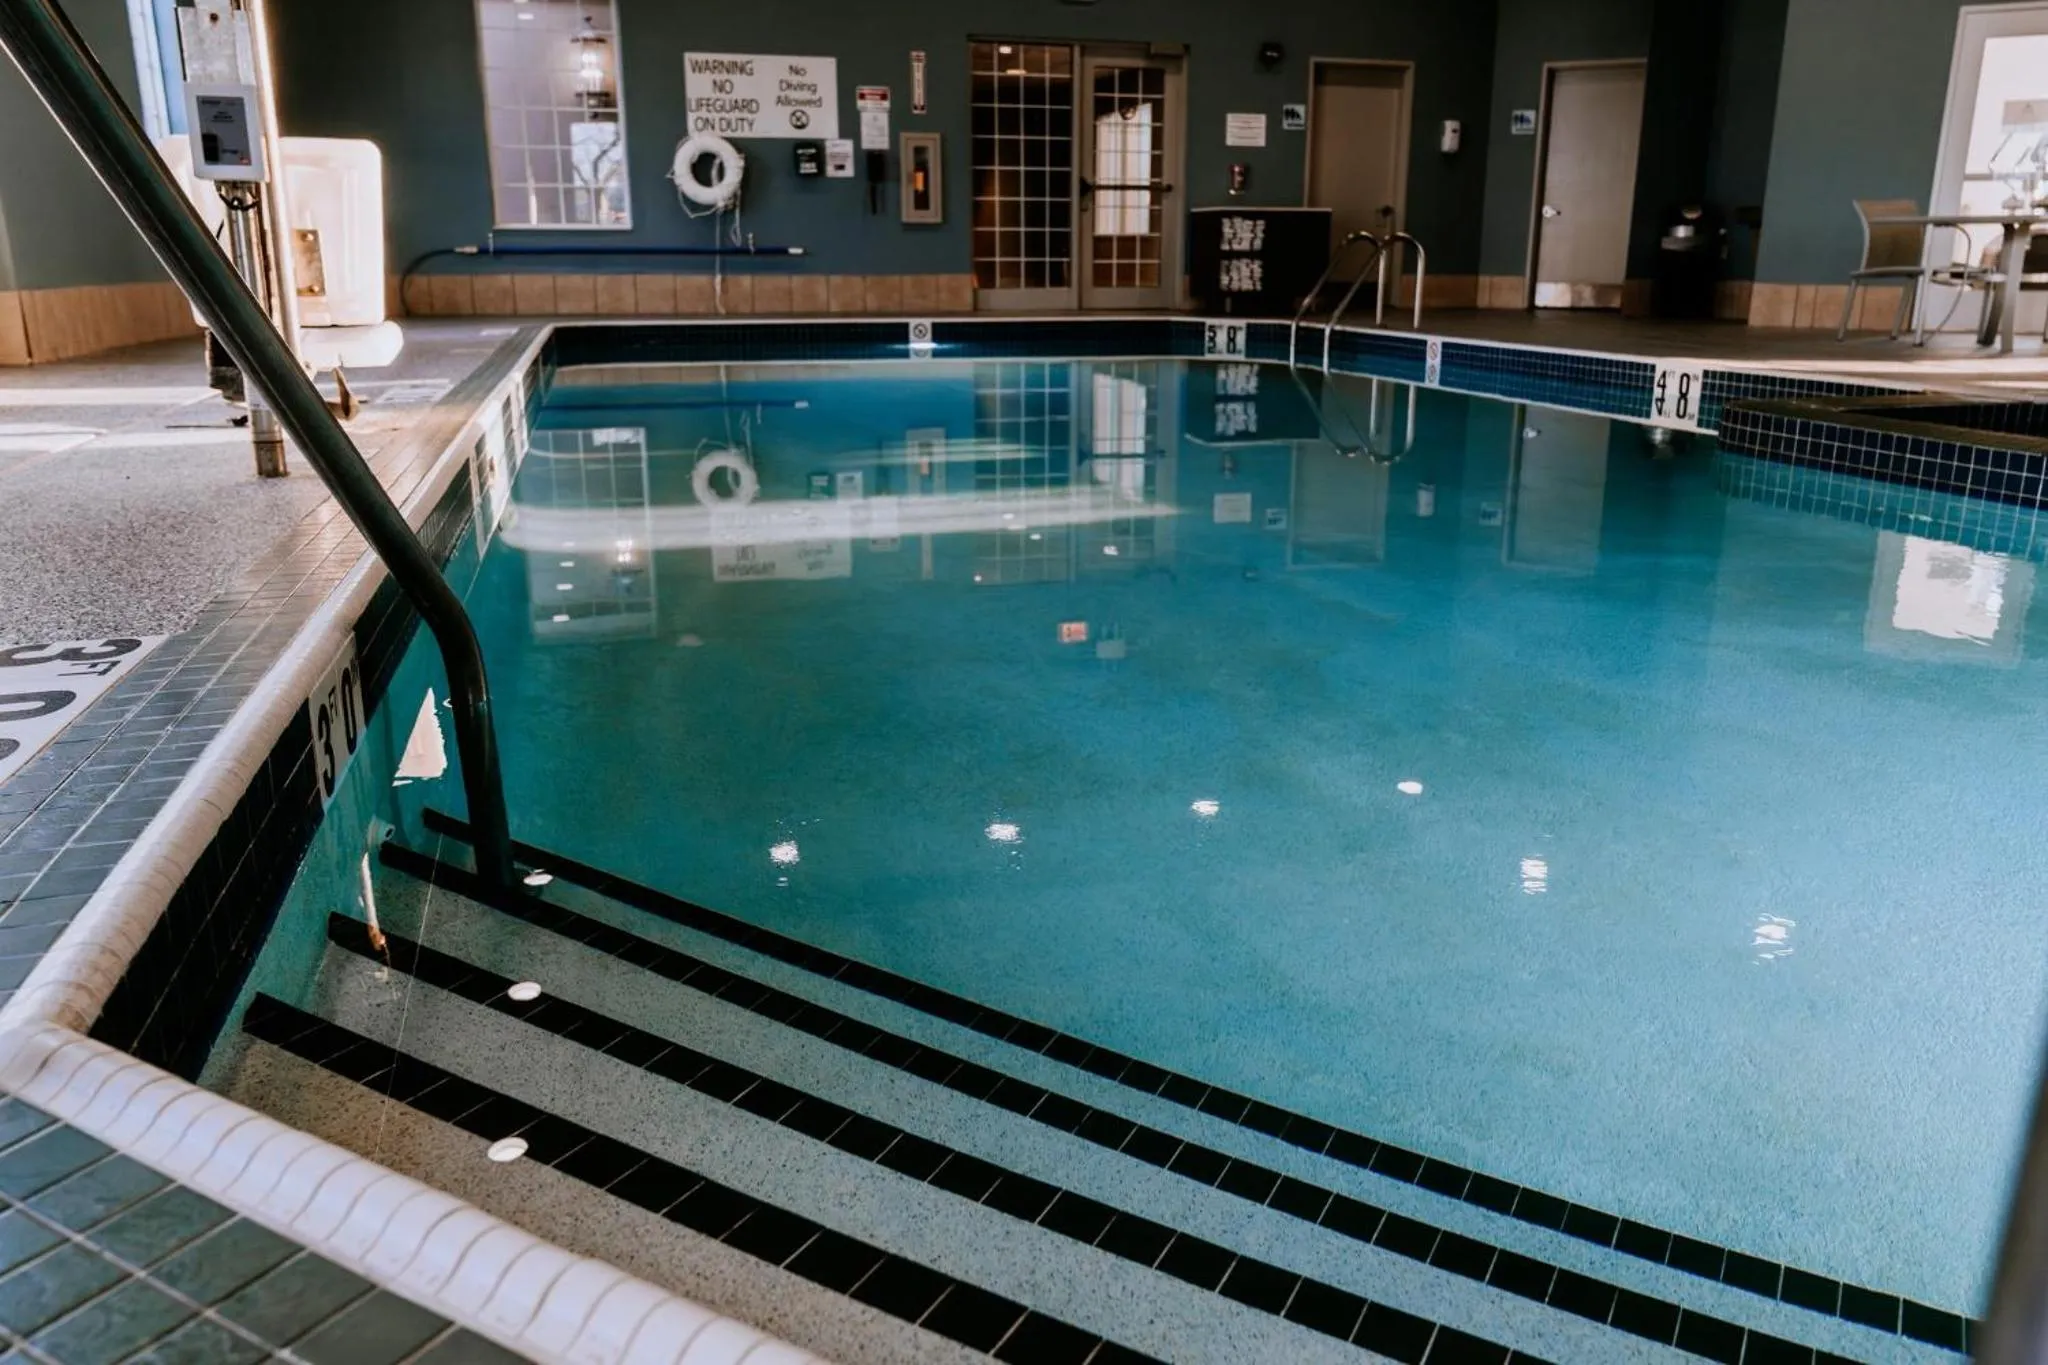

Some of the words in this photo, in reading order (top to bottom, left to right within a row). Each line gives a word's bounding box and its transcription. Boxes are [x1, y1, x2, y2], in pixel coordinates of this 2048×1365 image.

[688, 59, 754, 76] WARNING
[788, 64, 807, 77] No
[712, 79, 734, 94] NO
[779, 79, 818, 95] Diving
[688, 98, 760, 114] LIFEGUARD
[776, 95, 823, 107] Allowed
[694, 116, 715, 132] ON
[719, 117, 756, 132] DUTY
[318, 703, 335, 797] 3
[341, 667, 357, 755] 0
